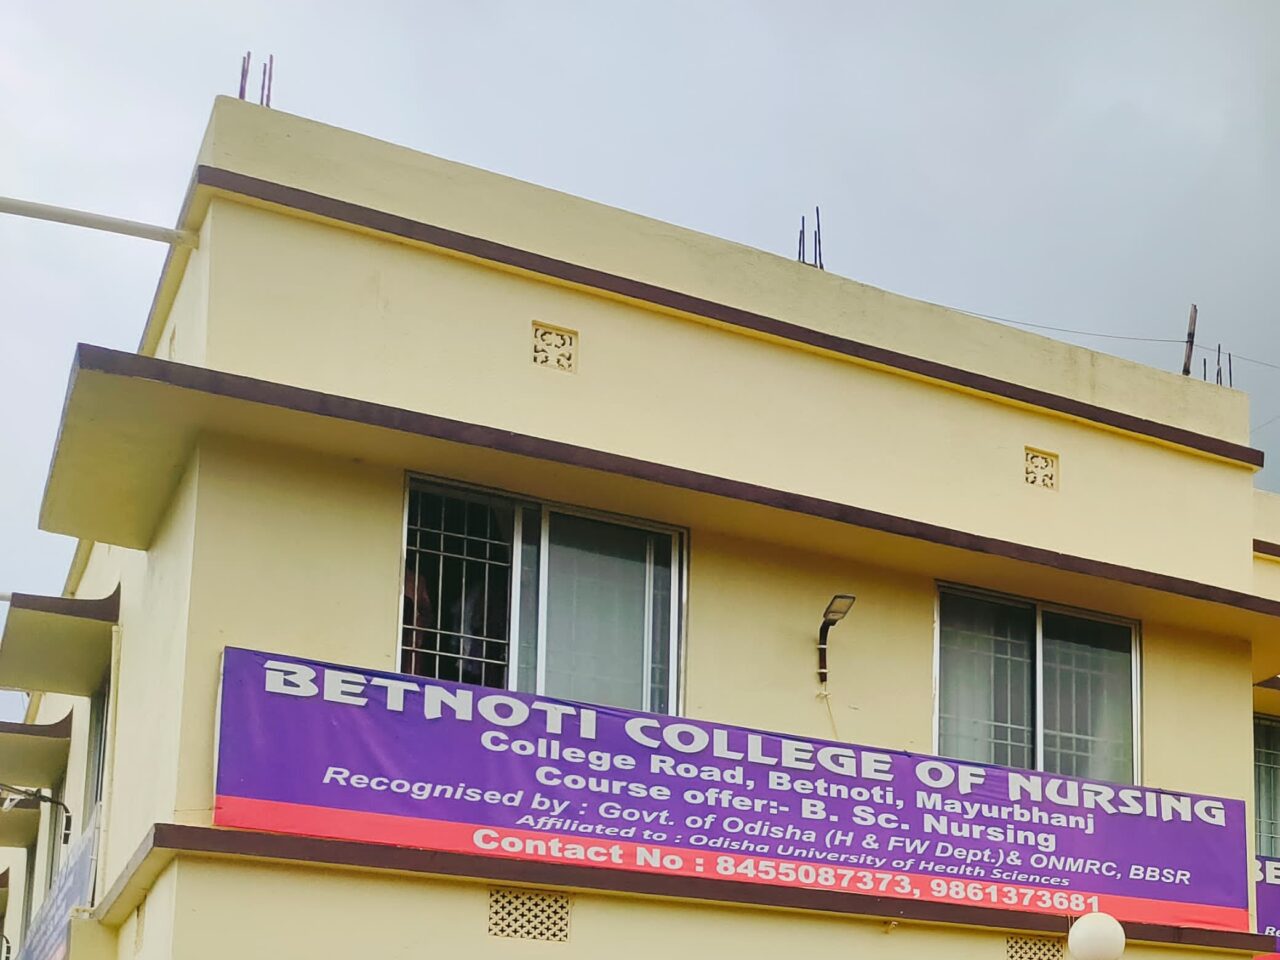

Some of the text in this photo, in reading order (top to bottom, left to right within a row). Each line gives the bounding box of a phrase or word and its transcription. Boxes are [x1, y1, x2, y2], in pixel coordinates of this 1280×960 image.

[263, 659, 1226, 827] BETNOTI COLLEGE OF NURSING
[480, 730, 1095, 835] College Road, Betnoti, Mayurbhanj
[322, 766, 524, 808] Recognised
[531, 793, 571, 816] by
[598, 802, 675, 826] Govt.
[685, 814, 716, 830] of
[722, 816, 817, 843] Odisha
[825, 829, 855, 849] (H
[862, 833, 880, 850] &
[888, 836, 930, 854] FW
[1030, 853, 1122, 880] ONMRC,
[1128, 864, 1192, 886] BBSR
[515, 814, 636, 838] Affiliated
[642, 828, 667, 842] to
[689, 834, 770, 854] Odisha
[776, 844, 887, 867] University
[892, 858, 914, 871] of
[918, 860, 987, 879] Health
[990, 868, 1070, 886] Sciences
[535, 766, 1056, 852] Course offer:- B. Sc. Nursing
[472, 828, 624, 865] Contact
[635, 846, 684, 870] No
[715, 855, 921, 898] 8455087373,
[930, 878, 1100, 913] 9861373681
